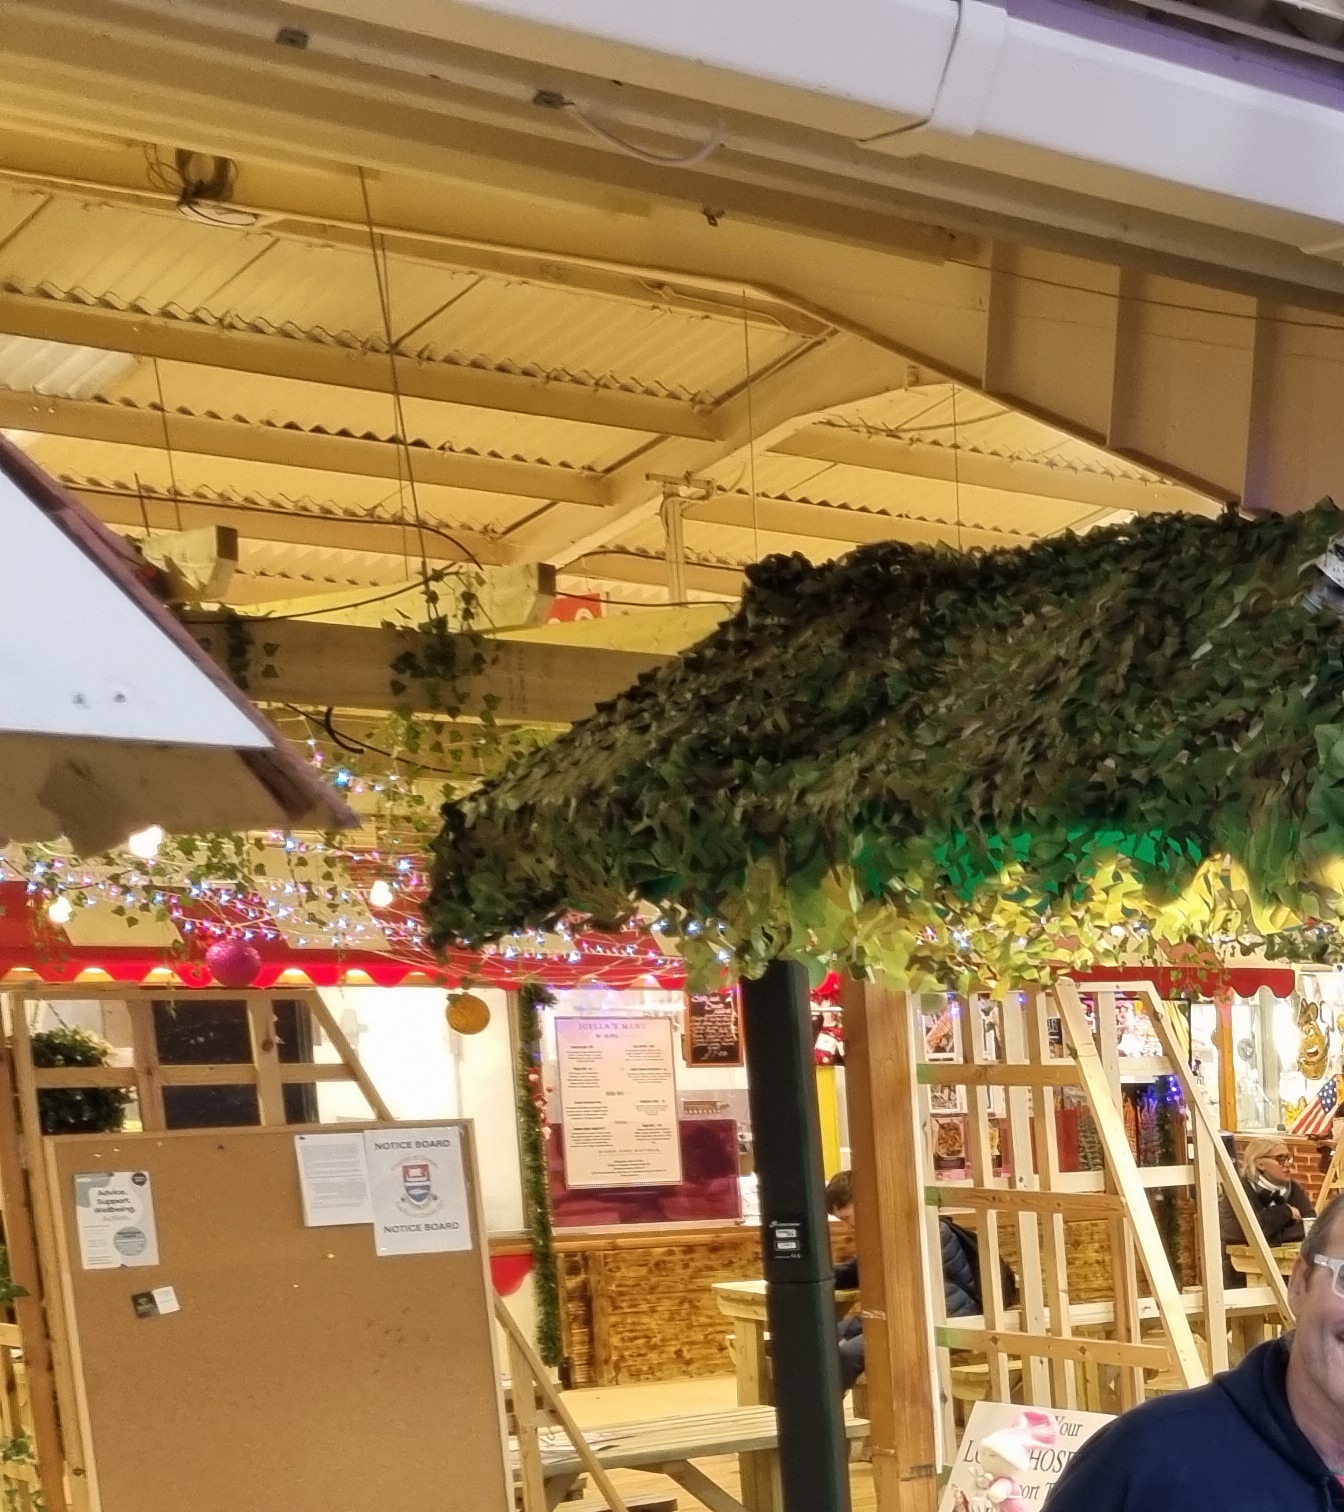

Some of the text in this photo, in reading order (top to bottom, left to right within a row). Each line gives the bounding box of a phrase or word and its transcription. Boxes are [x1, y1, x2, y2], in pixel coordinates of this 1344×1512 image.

[374, 1139, 451, 1150] NOTICE BOARD
[383, 1221, 460, 1233] NOTICE BOARD
